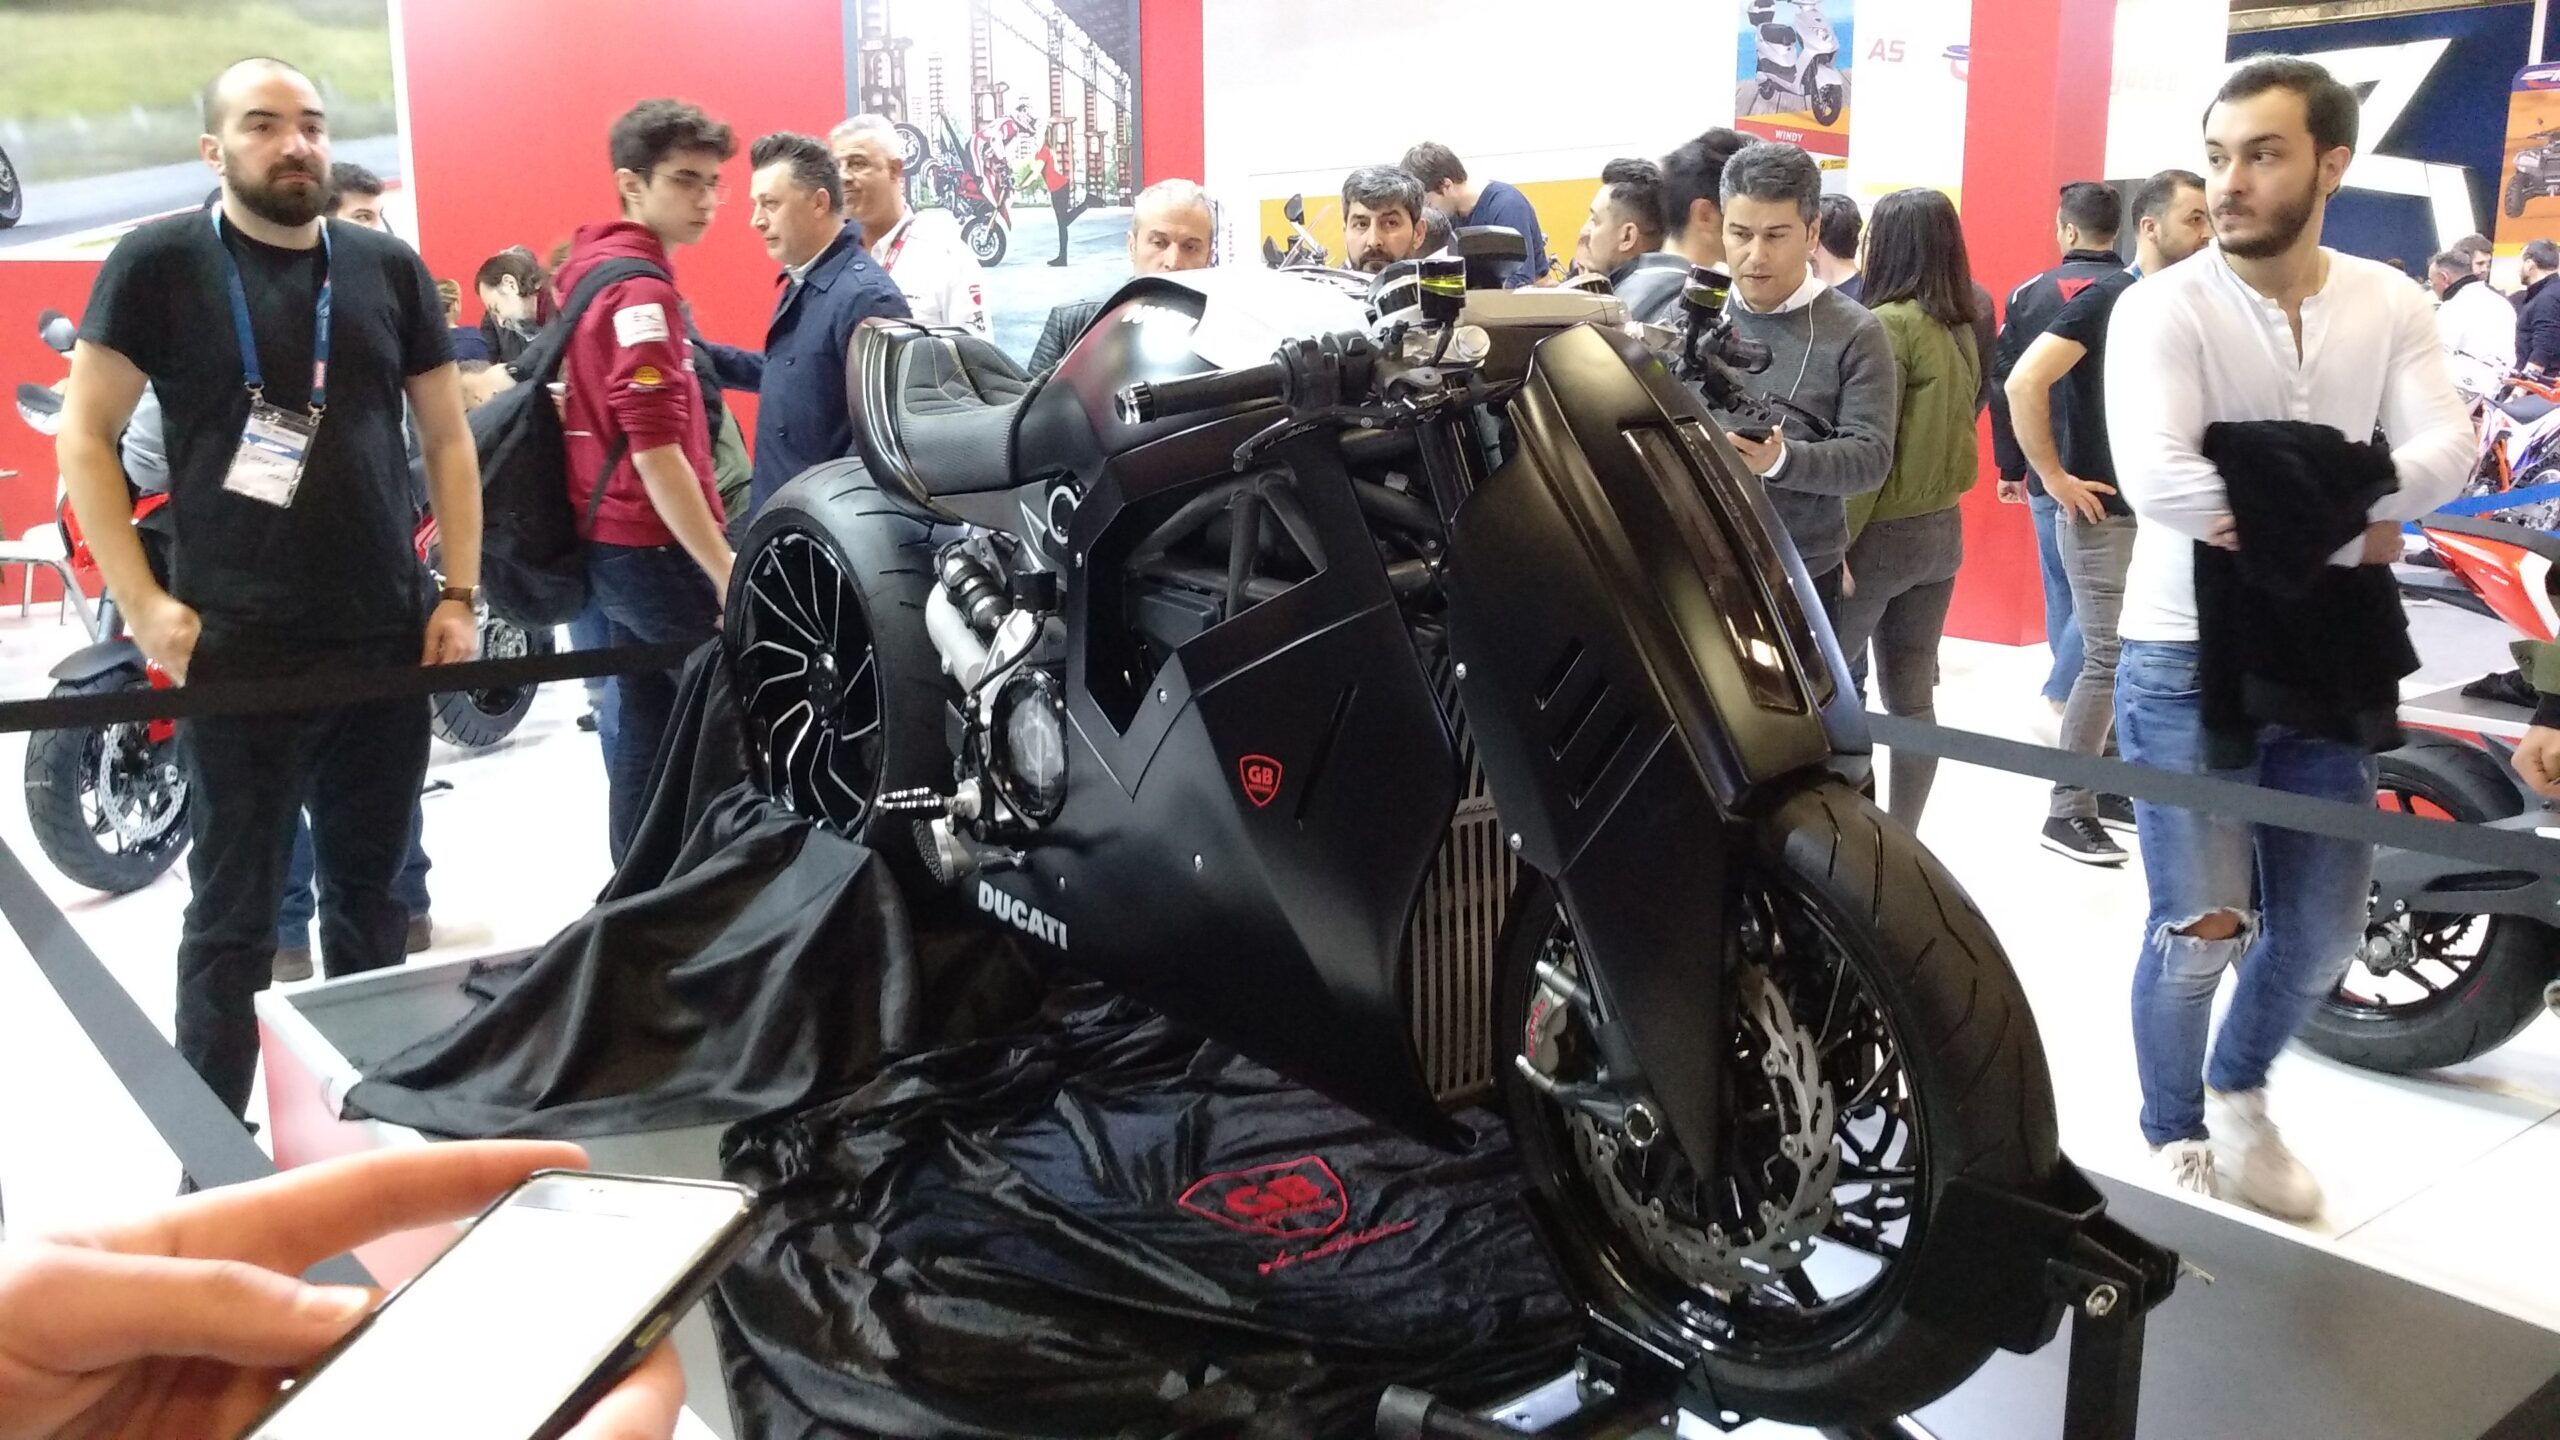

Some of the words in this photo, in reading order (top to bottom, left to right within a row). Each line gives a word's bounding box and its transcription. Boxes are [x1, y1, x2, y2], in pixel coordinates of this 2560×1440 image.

[1775, 129, 1803, 143] WINDY
[1248, 765, 1273, 784] GB
[978, 879, 1068, 951] DUCATI
